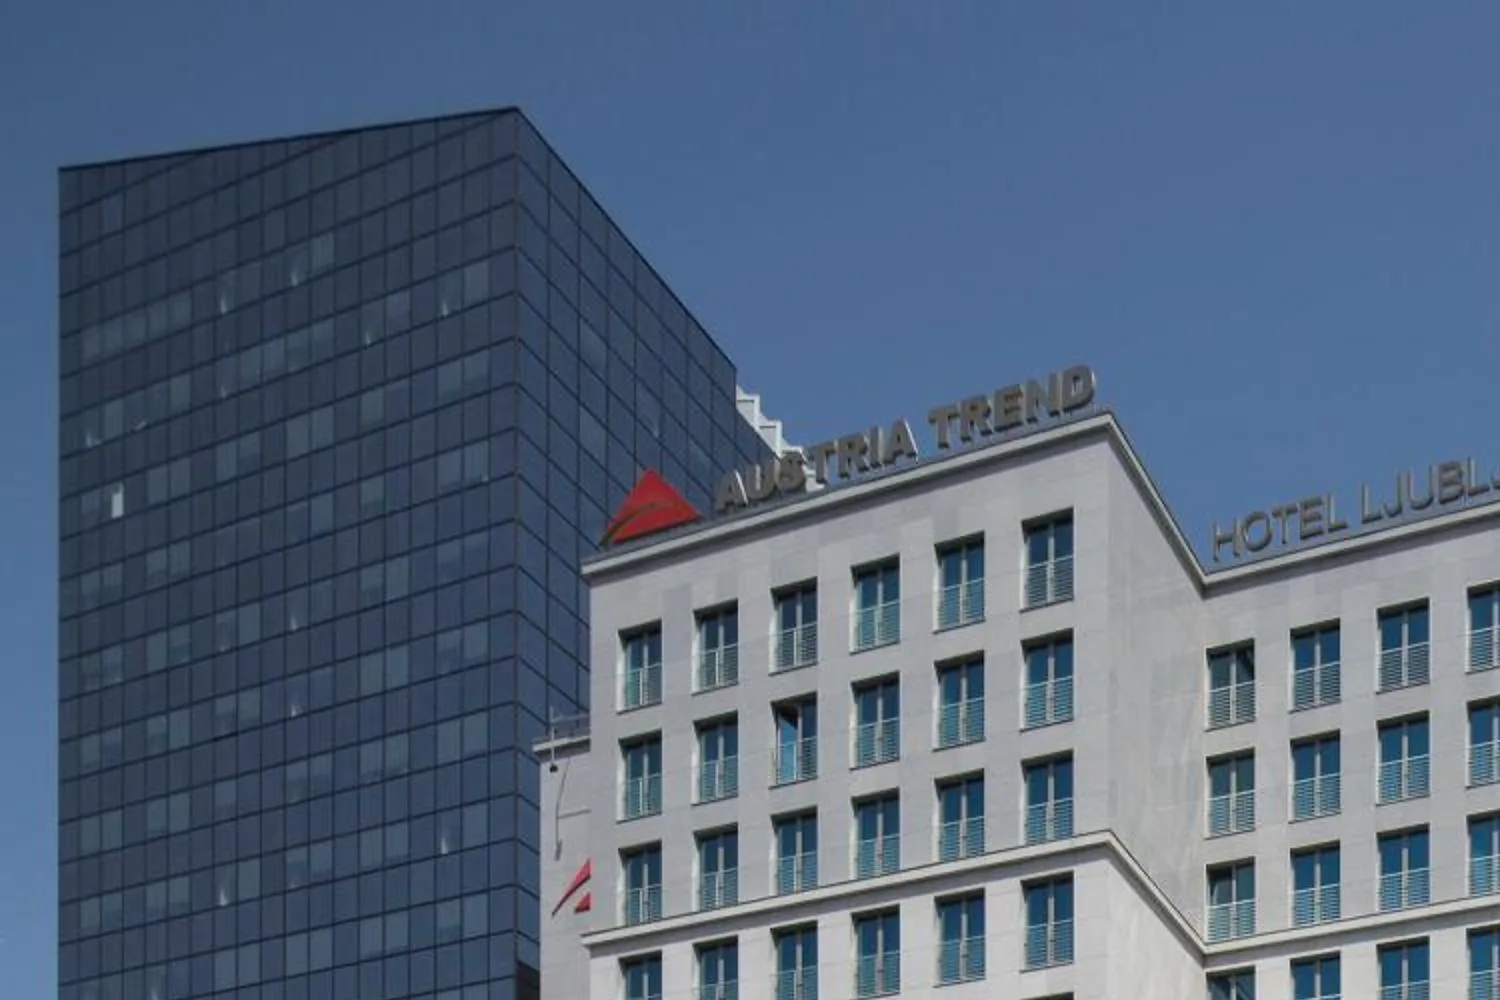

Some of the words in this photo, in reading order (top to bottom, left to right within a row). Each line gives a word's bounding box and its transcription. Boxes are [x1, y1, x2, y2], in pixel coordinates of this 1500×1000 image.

[715, 418, 920, 513] AUSTRIA
[928, 364, 1098, 448] TREND
[1211, 492, 1348, 562] HOTEL
